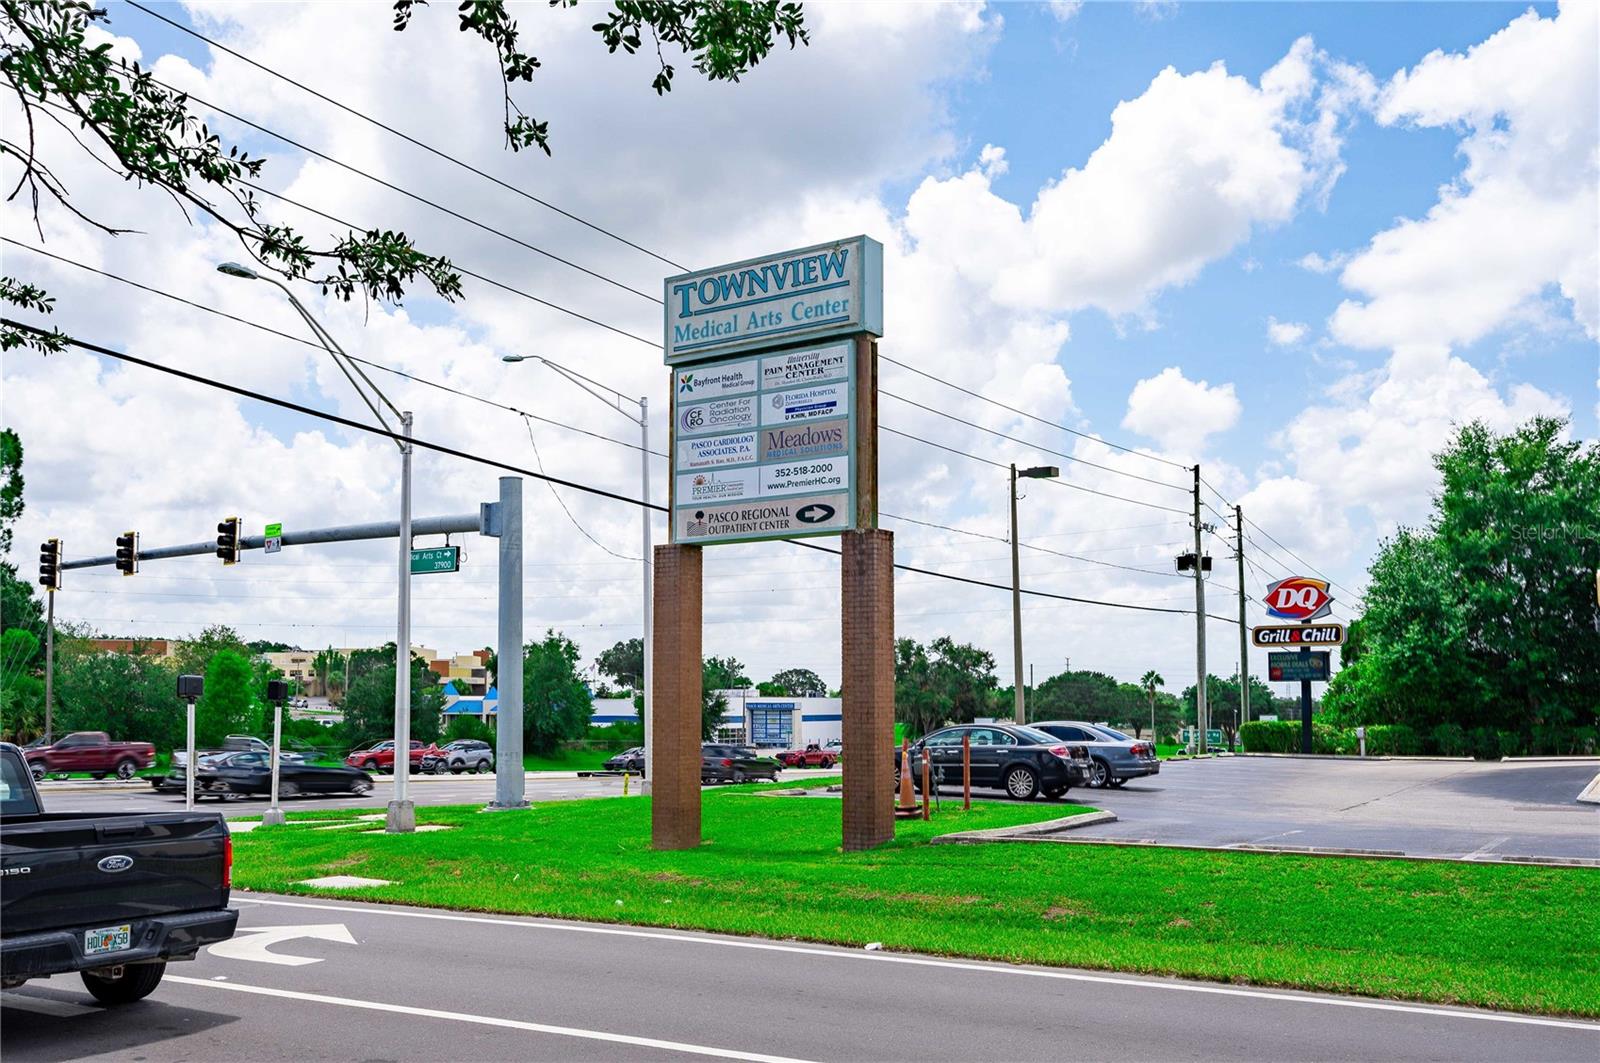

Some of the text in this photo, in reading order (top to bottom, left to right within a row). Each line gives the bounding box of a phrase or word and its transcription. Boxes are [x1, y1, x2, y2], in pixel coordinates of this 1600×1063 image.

[673, 249, 849, 318] TOWNVIEW
[674, 298, 849, 343] Medical Arts Center
[765, 356, 844, 376] PAIN MANAGEMENT
[694, 372, 743, 388] Bayfront Health
[786, 368, 824, 379] CENTER
[785, 388, 837, 402] FLORIDA HOSPITAL
[709, 400, 736, 410] Center
[709, 406, 750, 416] Radiation
[690, 410, 702, 419] CF
[709, 414, 752, 424] Oncology
[690, 418, 704, 426] RO
[691, 435, 754, 450] PASCO CARDIOLOGY
[768, 426, 842, 450] Meadows
[698, 446, 738, 458] ASSOCIATES,
[767, 442, 844, 458] MEDICAL SOLUTIONS
[774, 464, 833, 478] 352-518-2000
[692, 484, 727, 495] PREMIER
[767, 476, 841, 491] www.PremierHC.org
[708, 506, 790, 524] PASCO REGIONAL
[708, 520, 790, 535] OUTPATIENT CENTER
[436, 551, 442, 559] Ct
[1276, 586, 1318, 610] DQ
[1258, 630, 1290, 643] Grill
[1302, 628, 1336, 642] Chill
[106, 859, 126, 869] Ford
